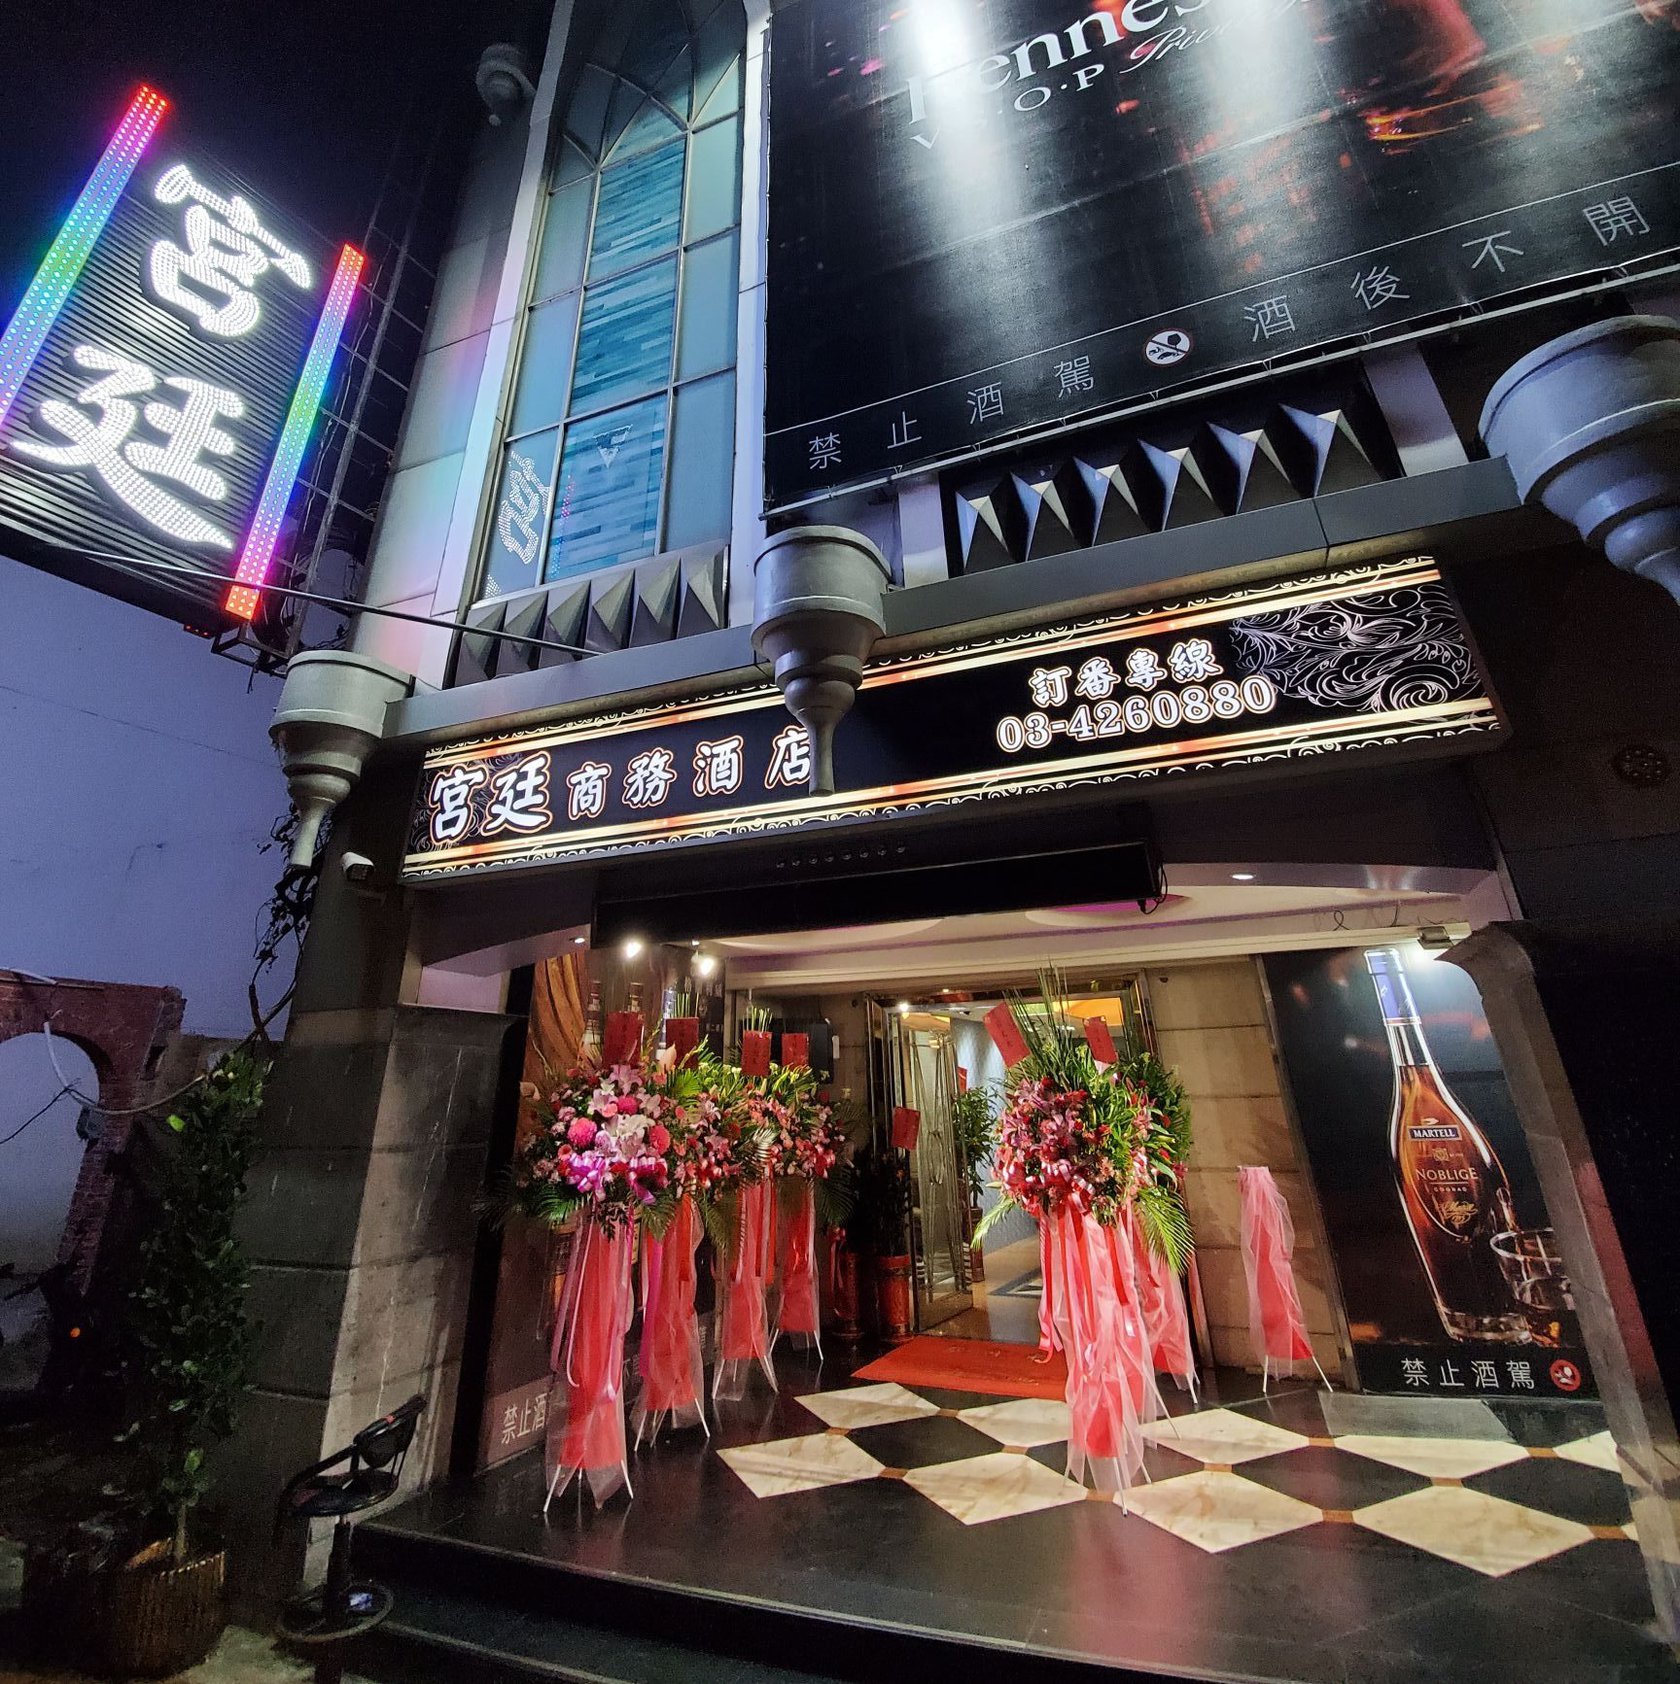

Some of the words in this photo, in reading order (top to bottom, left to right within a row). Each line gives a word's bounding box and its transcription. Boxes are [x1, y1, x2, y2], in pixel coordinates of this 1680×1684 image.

[10, 163, 312, 551] 宮廷
[808, 355, 1094, 471] 禁止酒駕
[1243, 195, 1651, 343] 酒後不開
[996, 675, 1276, 752] 03-4260880
[428, 724, 810, 845] 宮廷商務酒店
[1413, 1128, 1456, 1138] MARTELL
[1415, 1167, 1479, 1181] NOBLIGE
[1401, 1357, 1534, 1390] 禁止酒駕
